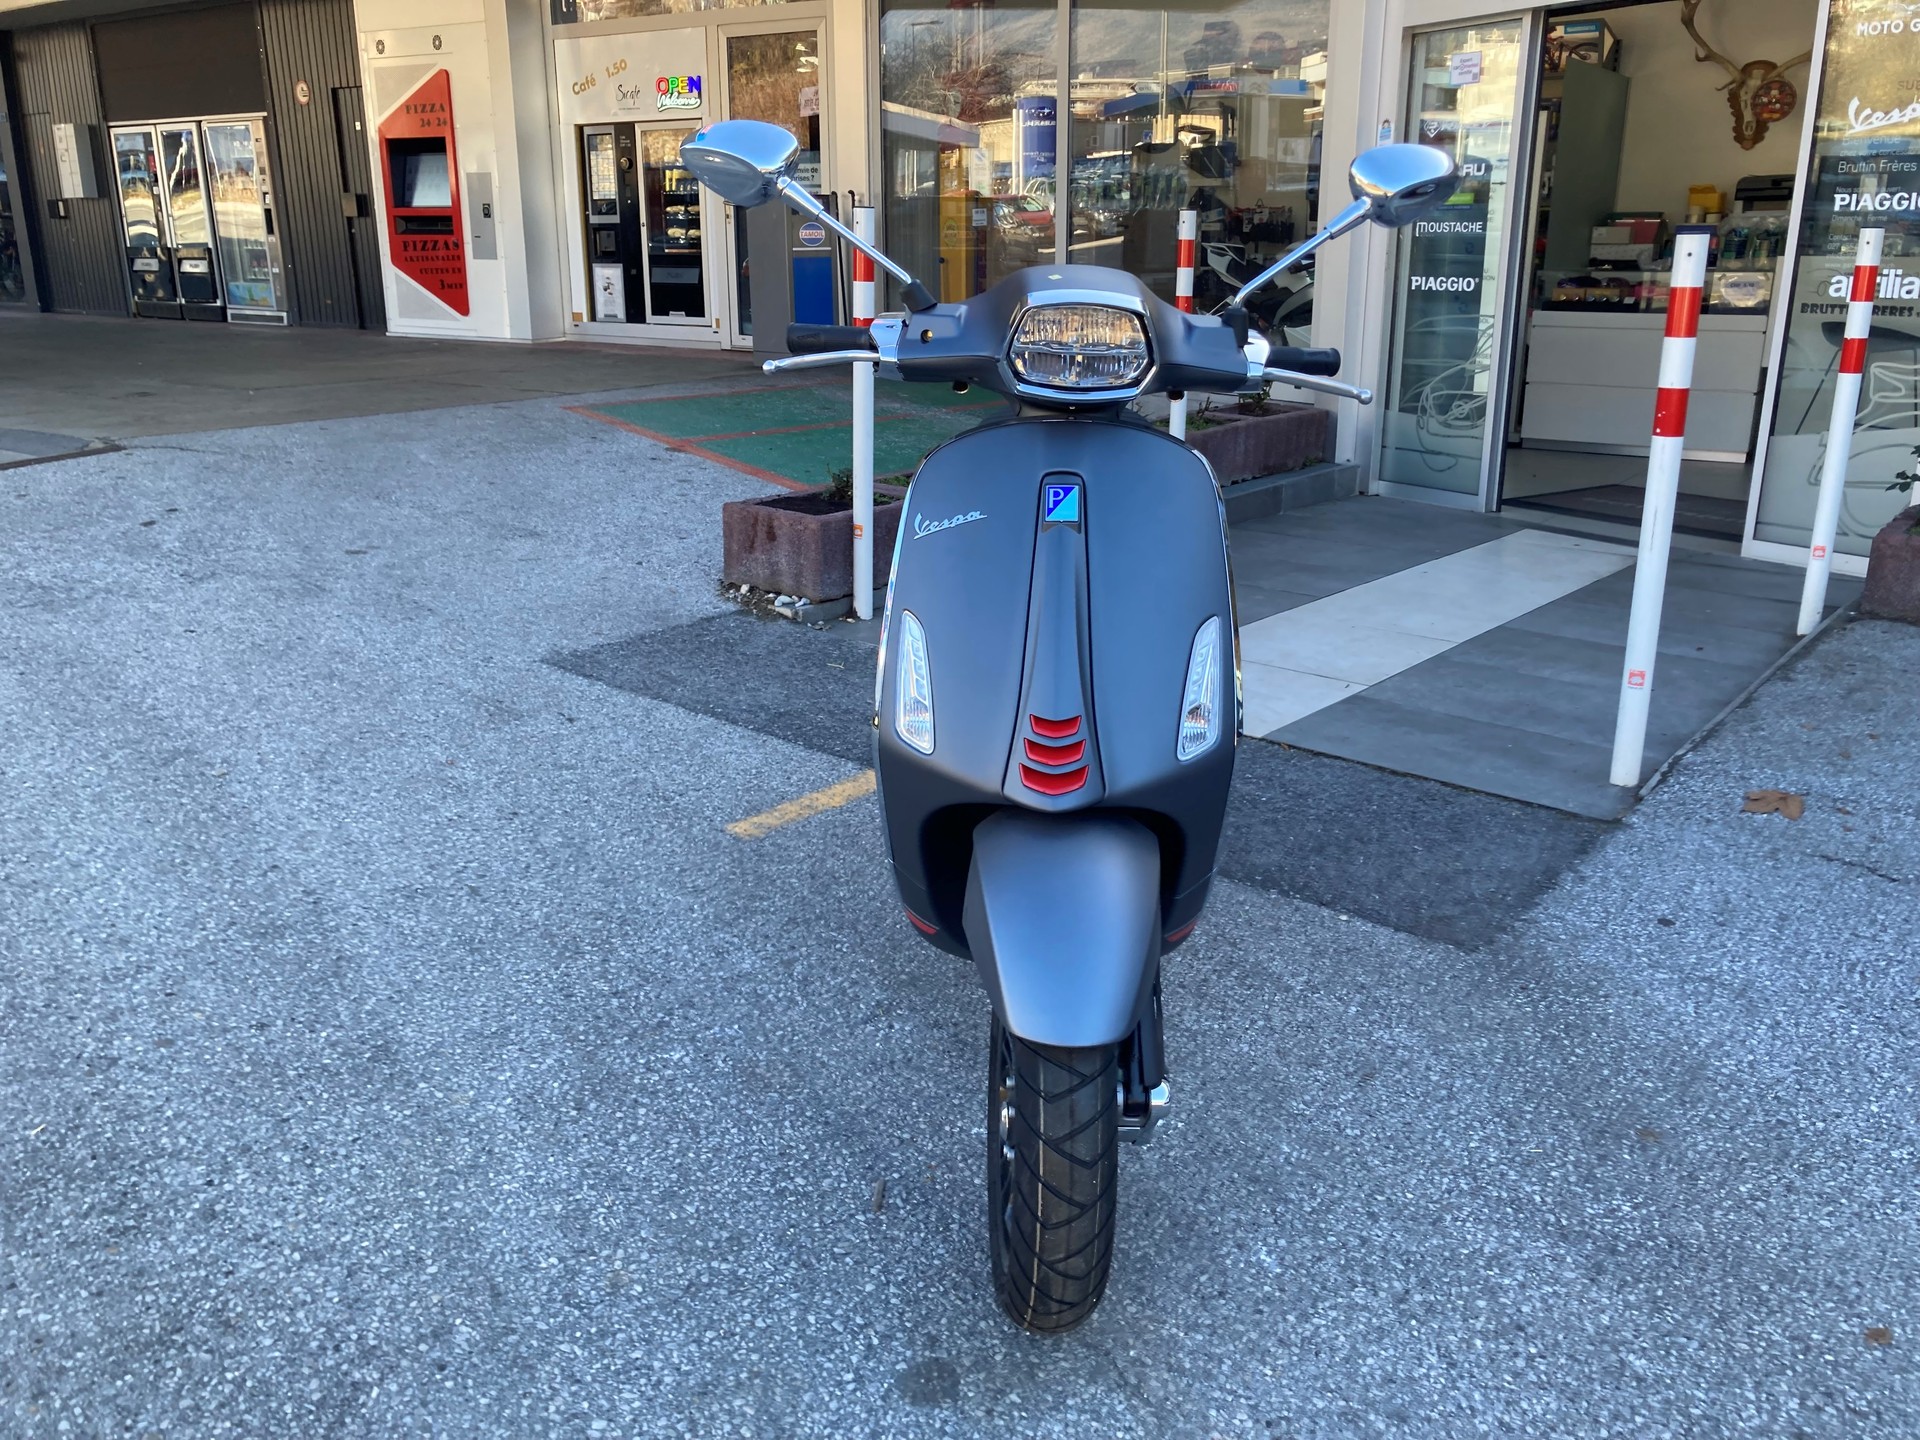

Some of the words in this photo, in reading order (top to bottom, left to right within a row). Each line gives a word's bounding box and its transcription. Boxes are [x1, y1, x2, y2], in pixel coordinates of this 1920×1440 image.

[1856, 20, 1904, 36] MOTO
[572, 73, 597, 95] Café
[605, 59, 628, 79] 1.50
[656, 75, 702, 95] OPEN
[405, 102, 446, 114] PIZZA
[656, 91, 702, 112] Welcome
[1842, 135, 1901, 146] Bienvenue
[810, 166, 819, 174] de
[1838, 161, 1876, 173] Bruttin
[1880, 160, 1917, 172] Frères
[1416, 222, 1483, 237] MOUSTACHE
[402, 238, 460, 252] PIZZAS
[1049, 488, 1065, 509] P
[914, 510, 988, 540] Vespa
